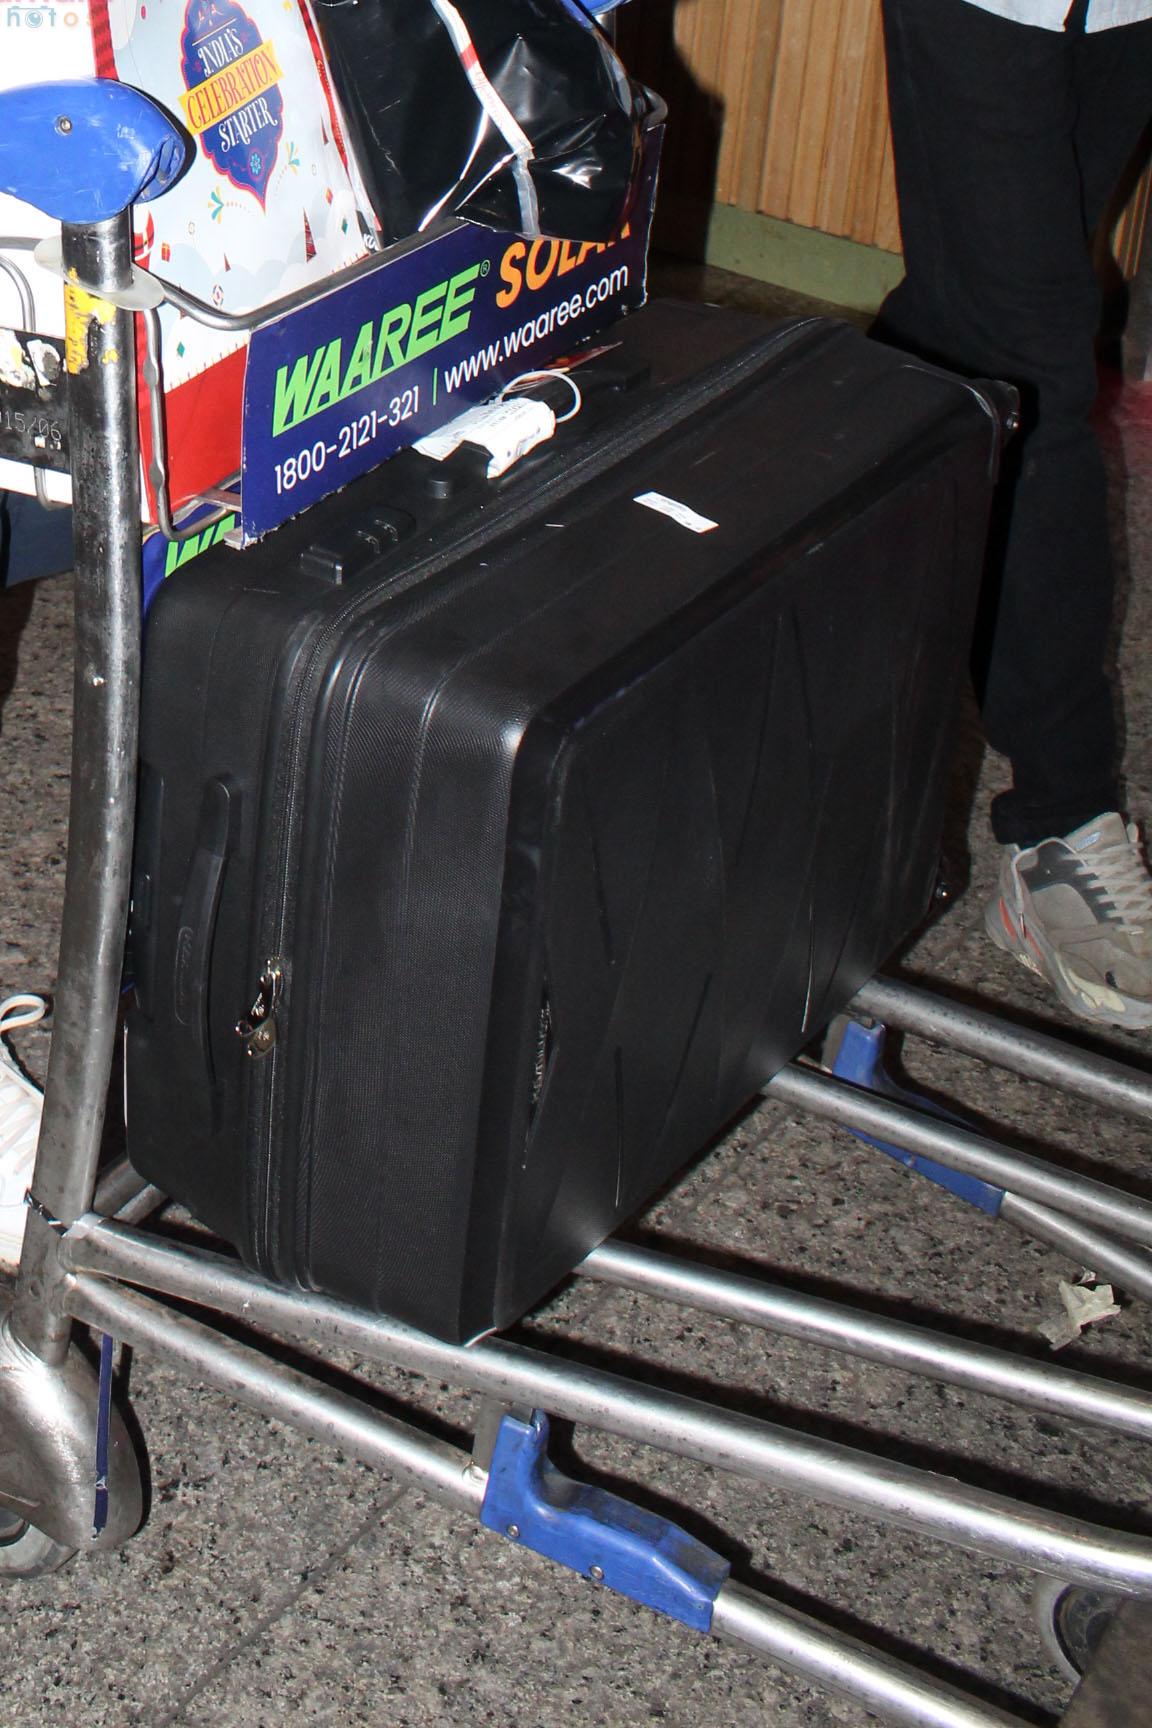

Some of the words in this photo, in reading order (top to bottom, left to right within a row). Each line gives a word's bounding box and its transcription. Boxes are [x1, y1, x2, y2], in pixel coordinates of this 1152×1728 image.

[186, 49, 279, 131] CELEBRATION
[197, 27, 244, 78] INDIA'S
[218, 96, 279, 153] STARTER
[495, 224, 631, 309] SOL
[274, 385, 421, 495] 1800-2121-321
[443, 265, 629, 394] www.waaree.com
